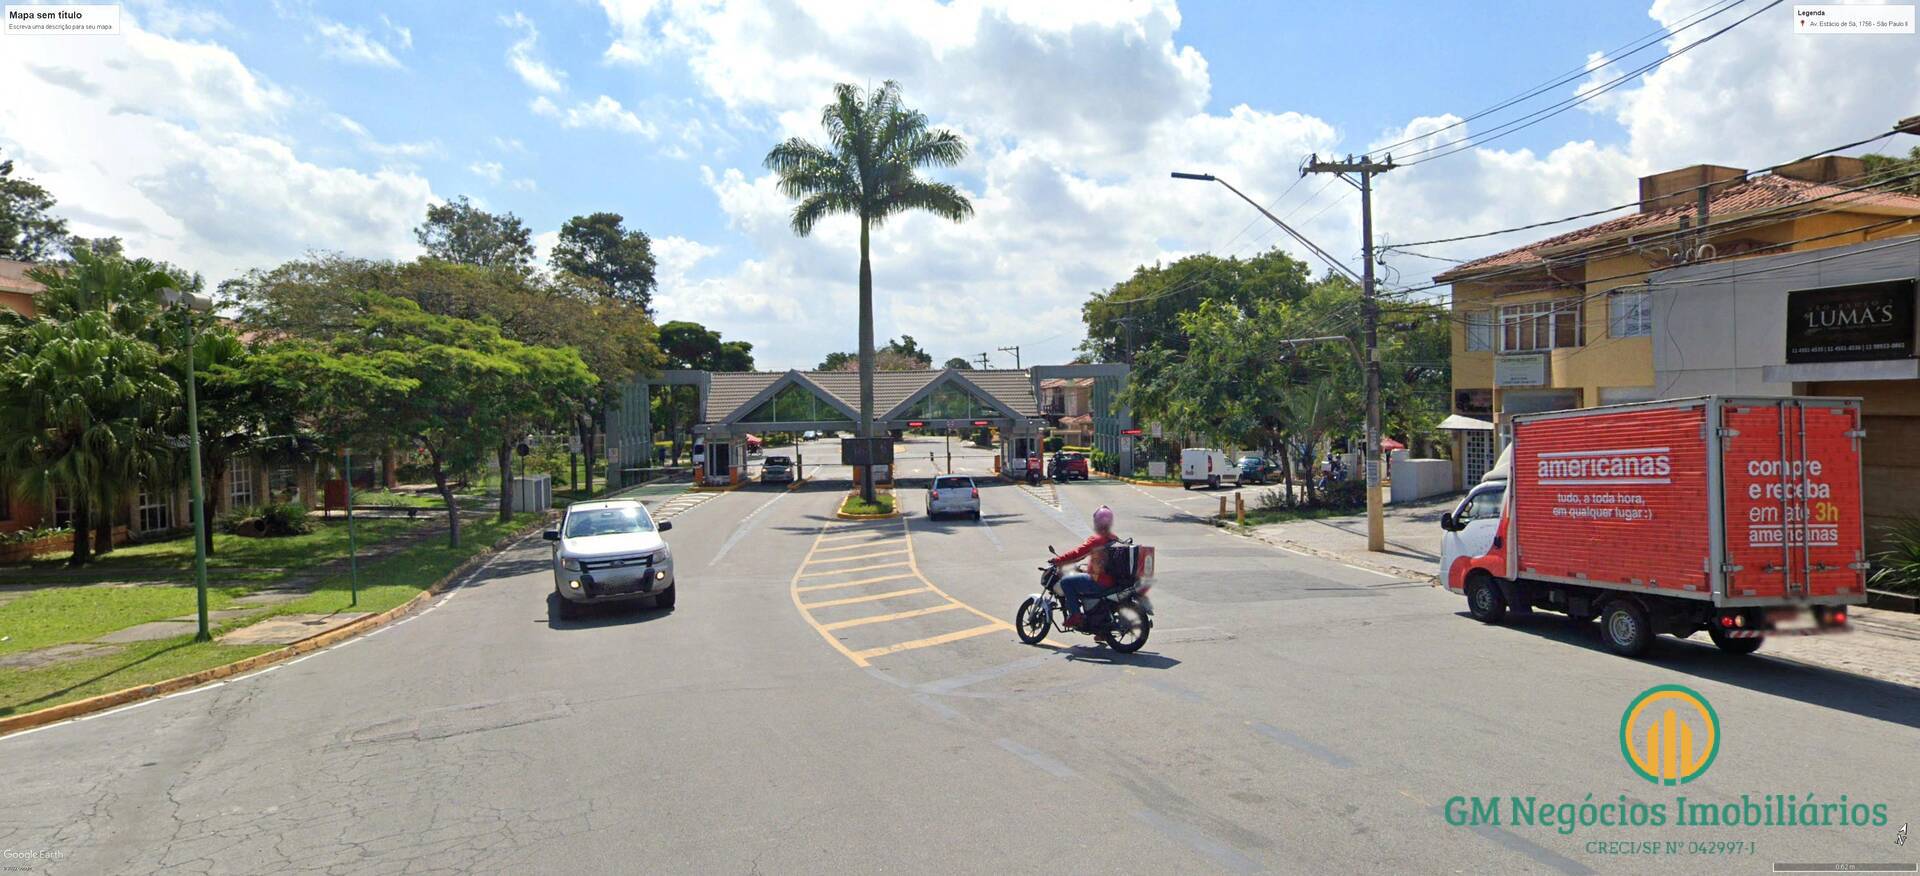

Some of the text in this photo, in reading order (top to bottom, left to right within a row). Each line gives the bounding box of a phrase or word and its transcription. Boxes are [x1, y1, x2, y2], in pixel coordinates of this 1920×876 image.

[1808, 304, 1894, 328] LUMA'S
[1537, 455, 1671, 478] americanas
[1749, 479, 1831, 499] e receba
[1558, 493, 1646, 506] tudo, a toda hora,
[1552, 507, 1567, 516] em
[1569, 507, 1612, 519] qualquer
[1749, 506, 1778, 522] em
[1815, 501, 1839, 522] 3h
[1749, 528, 1838, 542] ameicnas
